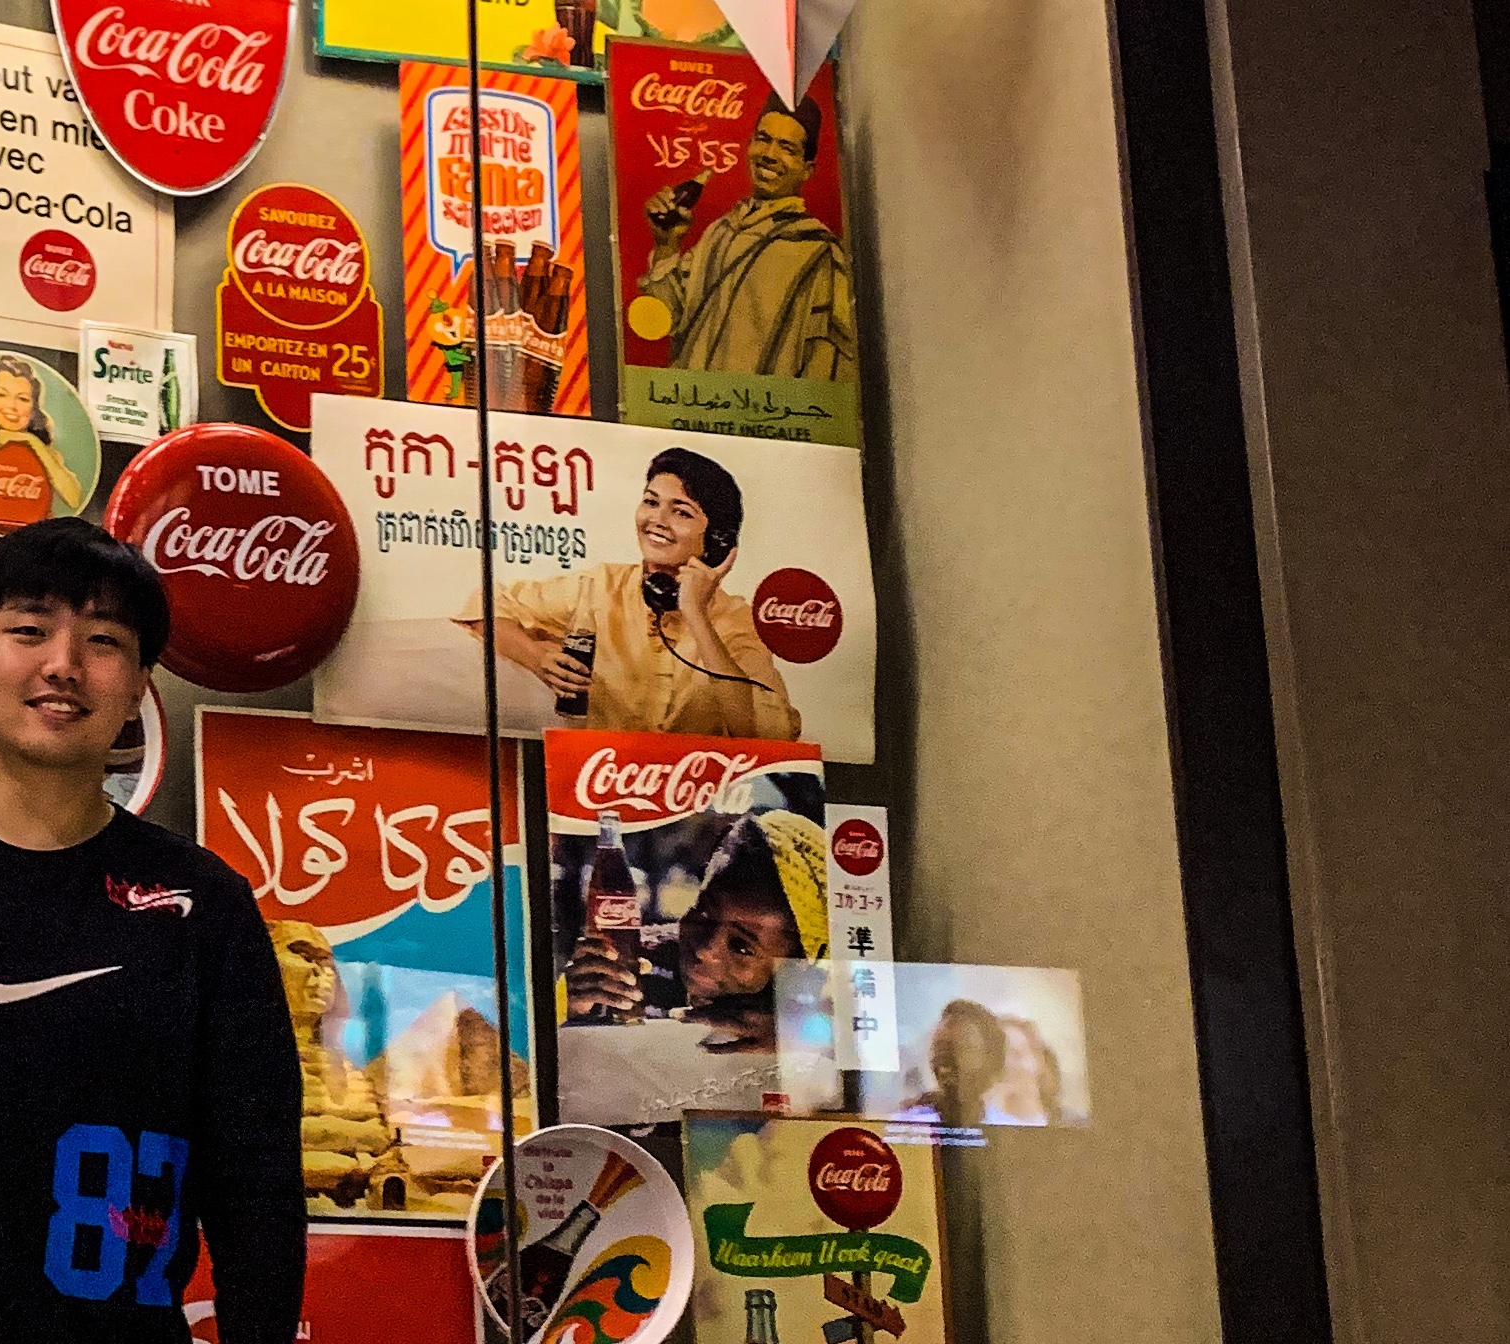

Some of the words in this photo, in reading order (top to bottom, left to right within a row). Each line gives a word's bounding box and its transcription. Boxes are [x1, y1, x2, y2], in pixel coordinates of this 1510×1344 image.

[75, 5, 273, 96] Coca-Cola
[631, 72, 748, 120] Coca-Cola
[123, 87, 226, 144] Coke
[51, 117, 106, 152] mie
[258, 206, 337, 231] SAVOUREZ
[23, 253, 92, 288] Coca-Cola
[234, 228, 363, 286] Coca-Cola
[266, 282, 287, 299] LA
[289, 287, 349, 306] MAISON
[92, 346, 154, 385] Sprite
[231, 357, 253, 374] UN
[259, 360, 321, 382] CARTON
[196, 465, 281, 497] TOME
[143, 506, 338, 586] Coca-Cola
[757, 596, 834, 630] Coca-Cola
[574, 746, 760, 815] Coca-Cola
[815, 1162, 893, 1193] Coca-Cola
